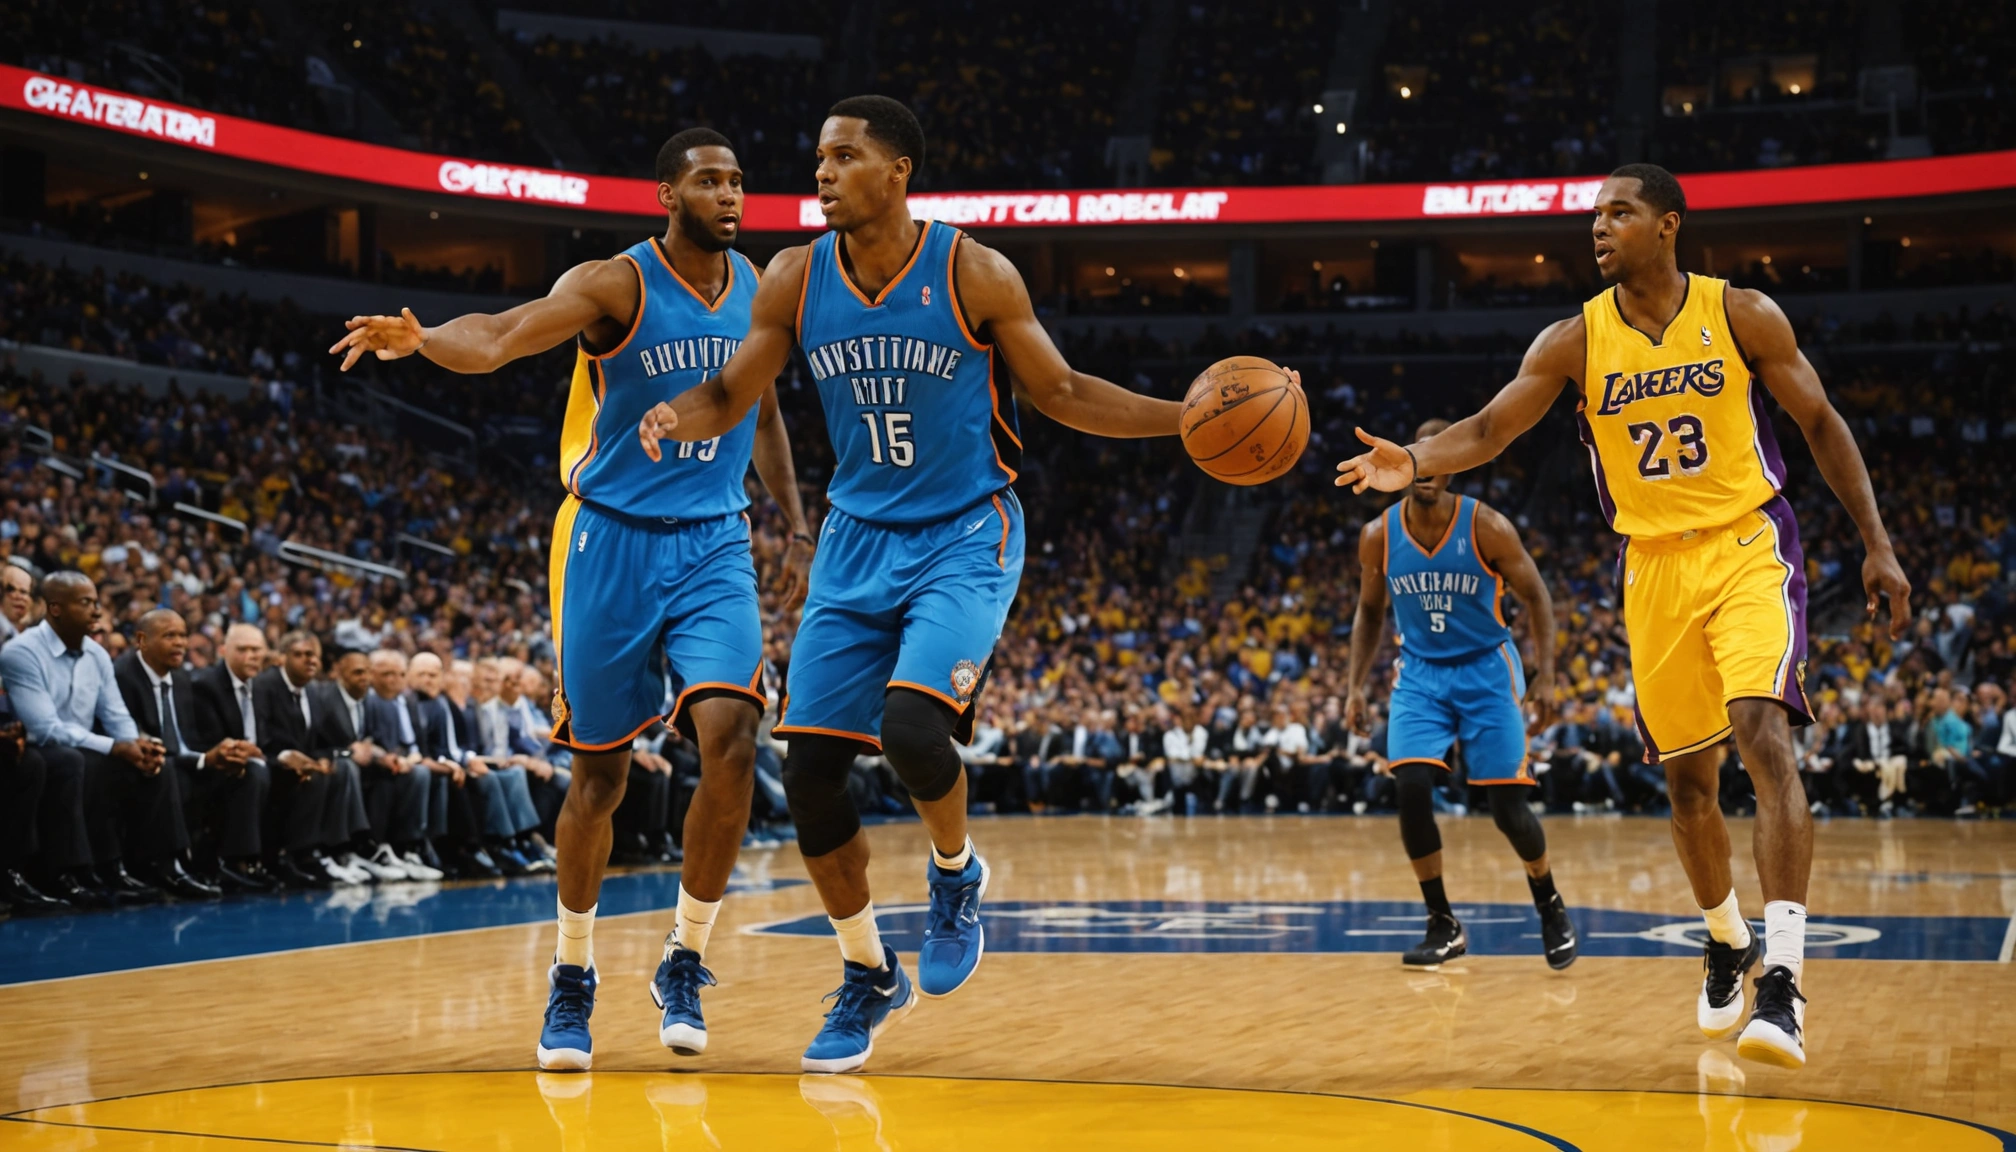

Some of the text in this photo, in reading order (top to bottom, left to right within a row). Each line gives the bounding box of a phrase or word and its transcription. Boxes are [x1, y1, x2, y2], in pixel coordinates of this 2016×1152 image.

[861, 412, 915, 467] 15
[1628, 414, 1710, 480] 23
[1430, 612, 1446, 633] 5
